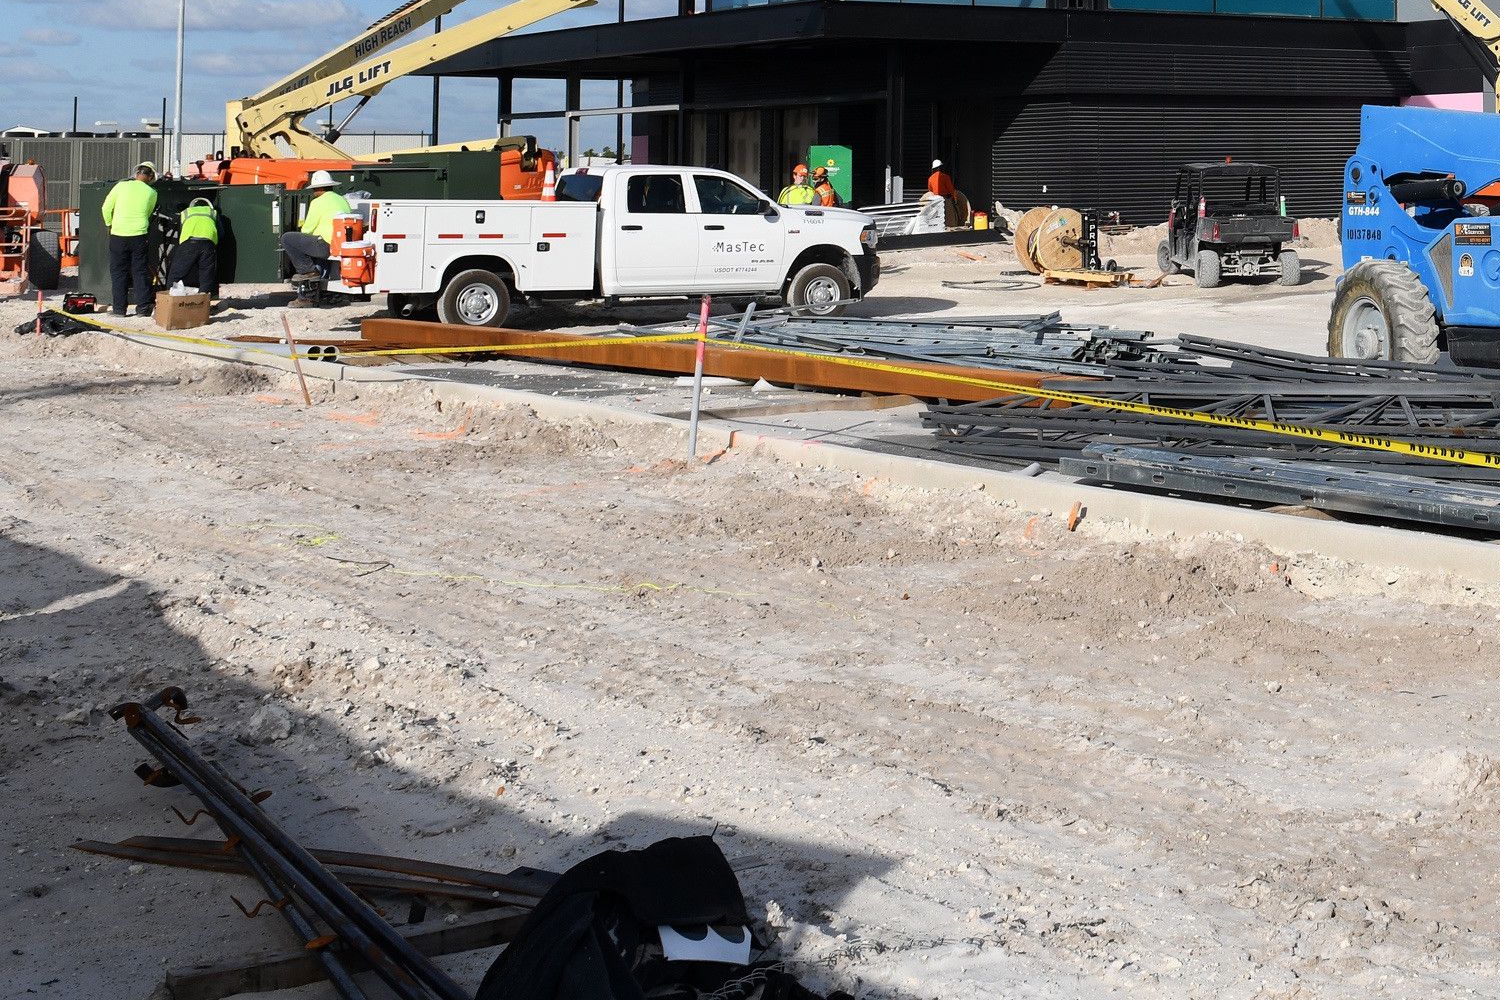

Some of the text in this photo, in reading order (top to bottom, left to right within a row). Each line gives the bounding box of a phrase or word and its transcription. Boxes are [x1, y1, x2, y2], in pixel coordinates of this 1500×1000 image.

[1470, 7, 1491, 27] LIFT
[355, 17, 412, 58] HIGH REACH
[326, 61, 391, 98] JLG LIFT
[1348, 206, 1380, 216] GTH-844
[1347, 229, 1382, 240] 10137848
[716, 241, 765, 253] MasTec
[1339, 432, 1391, 448] CAUTION
[1409, 443, 1465, 460] CAUTION
